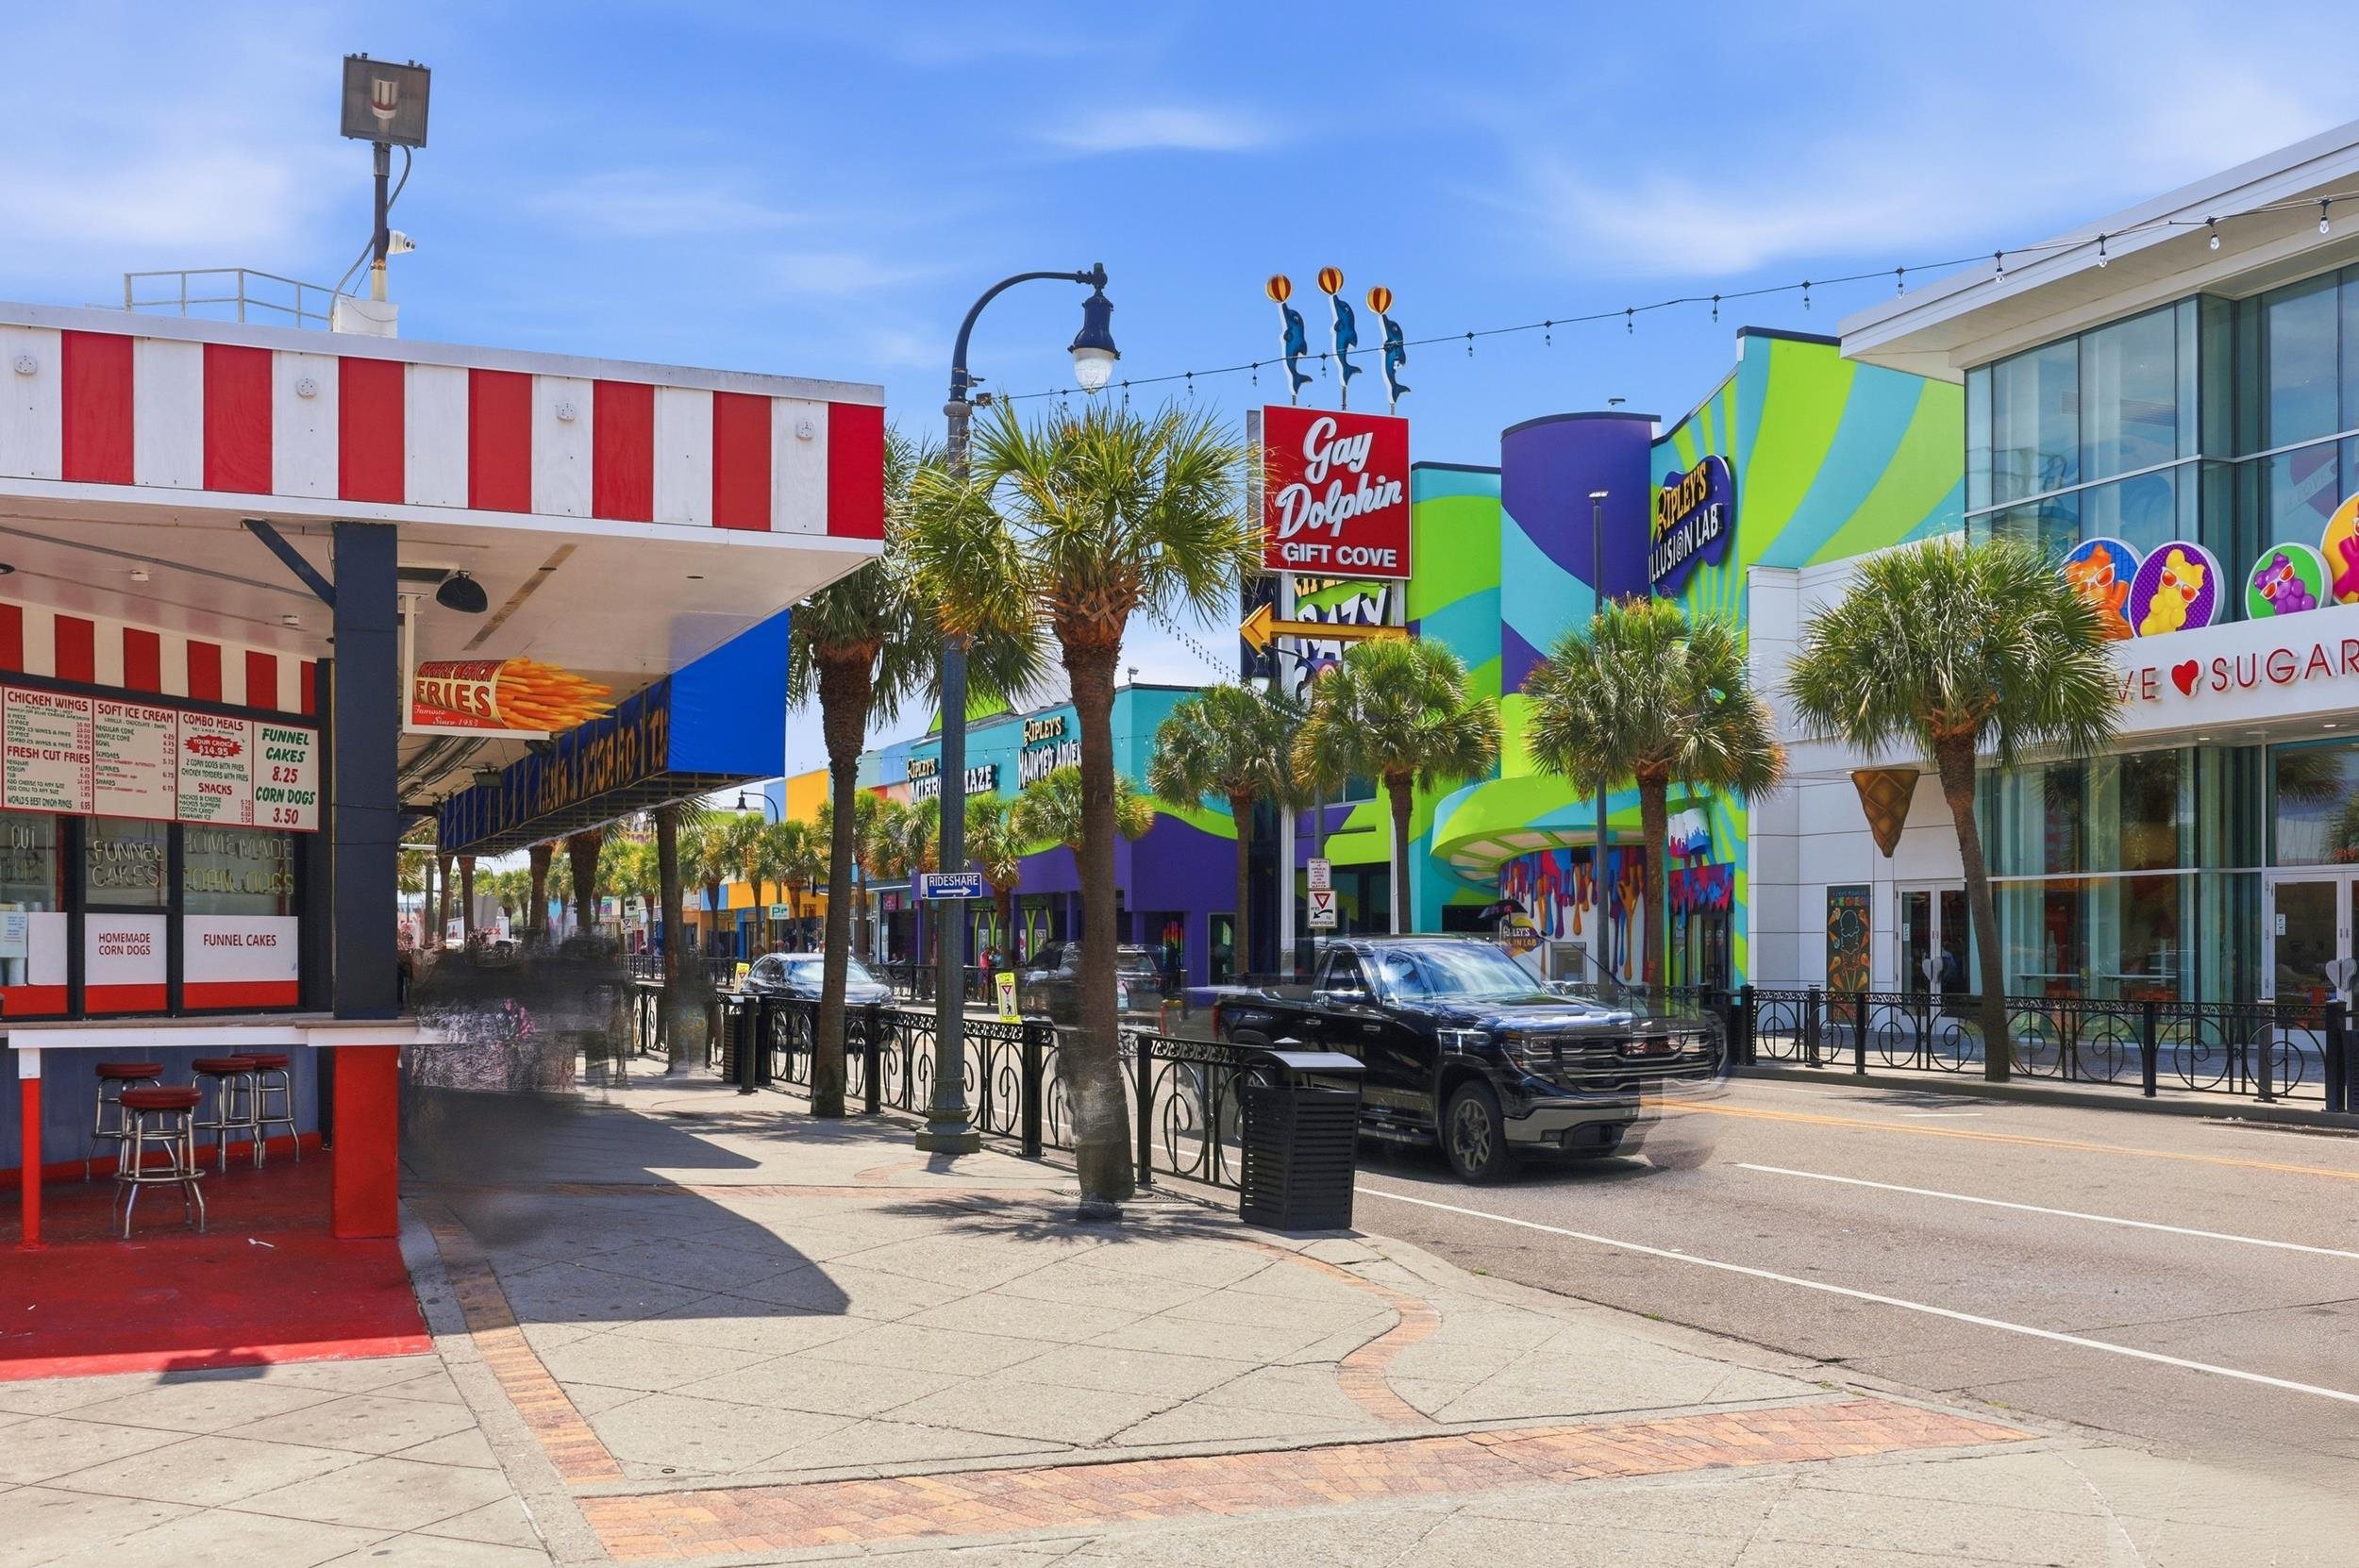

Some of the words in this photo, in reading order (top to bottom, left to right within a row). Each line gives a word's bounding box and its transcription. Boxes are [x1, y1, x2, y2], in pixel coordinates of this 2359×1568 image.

[1302, 416, 1374, 485] Gay
[1276, 473, 1403, 541] Dolphin
[1657, 461, 1707, 542] RIPLEY'S
[1648, 521, 1693, 585] ILLUSION
[1696, 504, 1718, 548] LAB
[1281, 542, 1332, 564] GIFT
[1335, 545, 1397, 568] COVE
[2117, 667, 2156, 703] VE
[2211, 639, 2359, 692] SUGAR
[8, 692, 51, 707] CHICKEN
[55, 698, 88, 711] WINGS
[416, 680, 492, 718] FRIES
[98, 703, 123, 716] SOFT
[125, 708, 140, 719] ICE
[142, 709, 174, 724] CREAM
[183, 714, 213, 726] COMBO
[216, 718, 243, 731] MEALS
[262, 728, 310, 745] FUNNEL
[1024, 716, 1062, 747] RIPLEY'S
[8, 746, 40, 759] FRESH
[42, 750, 60, 760] CUT
[64, 752, 91, 764] FRIES
[205, 760, 218, 769] DOGS
[266, 747, 305, 763] CAKES
[273, 766, 298, 783] 8.25
[1018, 744, 1054, 789] HAUNTED
[198, 782, 233, 795] SNACKS
[256, 786, 285, 803] CORN
[287, 789, 316, 806] DOGS
[274, 808, 299, 825] 3.50
[11, 824, 37, 850] CUT
[93, 840, 164, 862] FUNNEL
[92, 865, 159, 889] CAKES
[929, 875, 979, 887] RIDESHARE
[98, 933, 151, 943] HOMEMADE
[203, 934, 243, 946] FUNNEL
[246, 934, 276, 947] CAKES
[98, 944, 124, 956] CORN
[126, 944, 151, 956] DOGS
